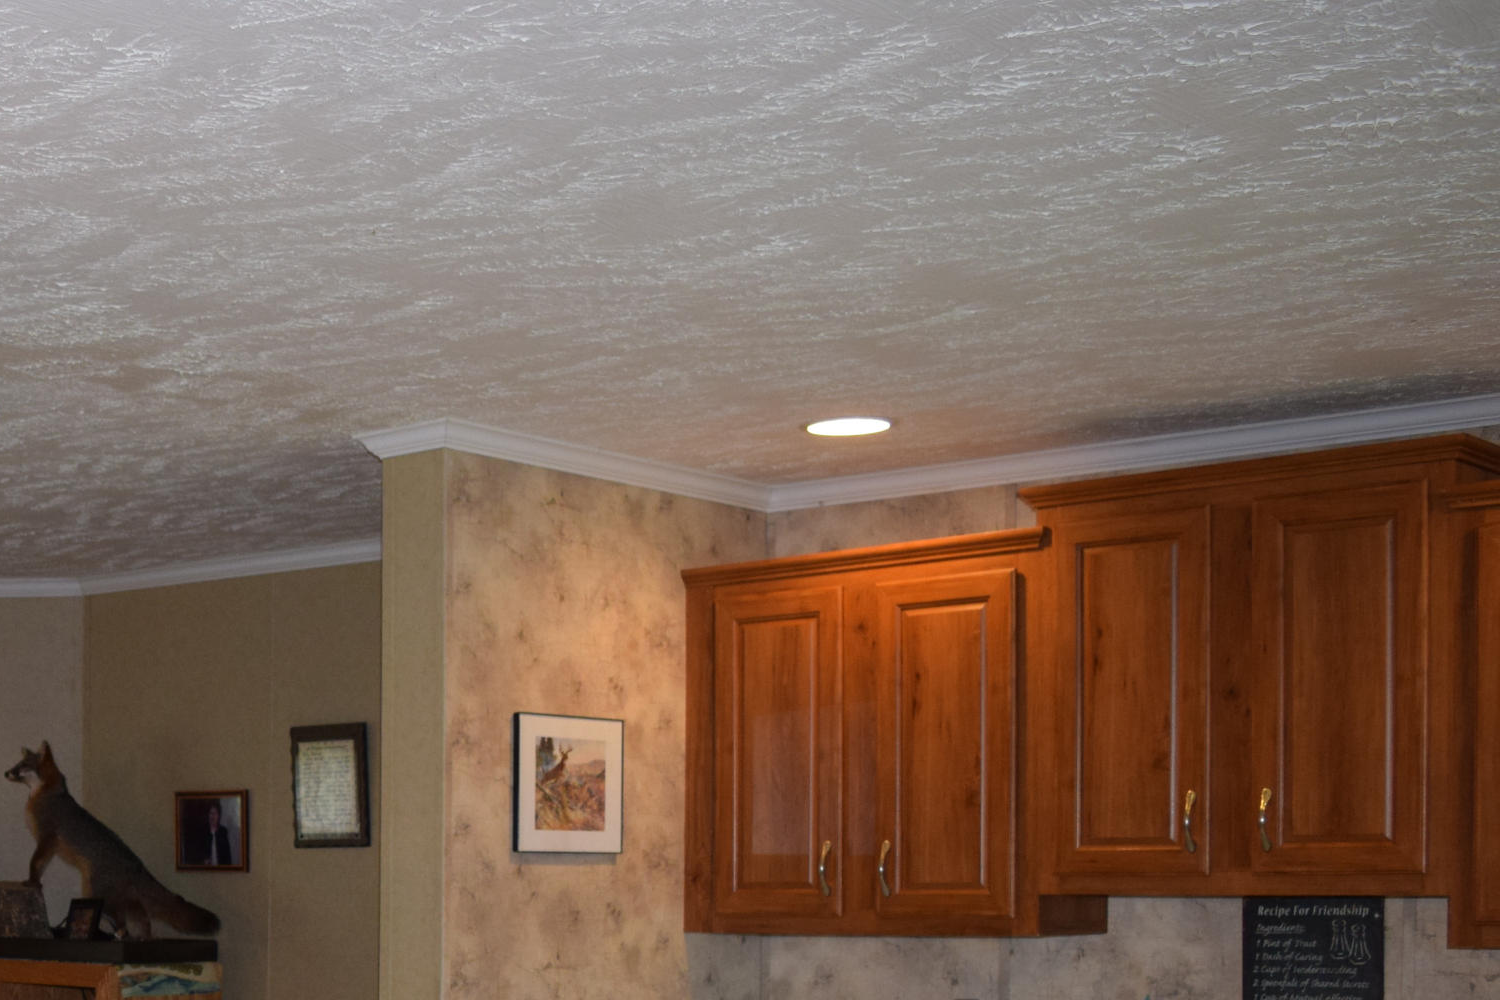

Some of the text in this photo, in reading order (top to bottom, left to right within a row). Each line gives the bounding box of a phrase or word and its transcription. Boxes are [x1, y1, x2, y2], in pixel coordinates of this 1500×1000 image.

[1257, 904, 1369, 918] Recipe For Friendship
